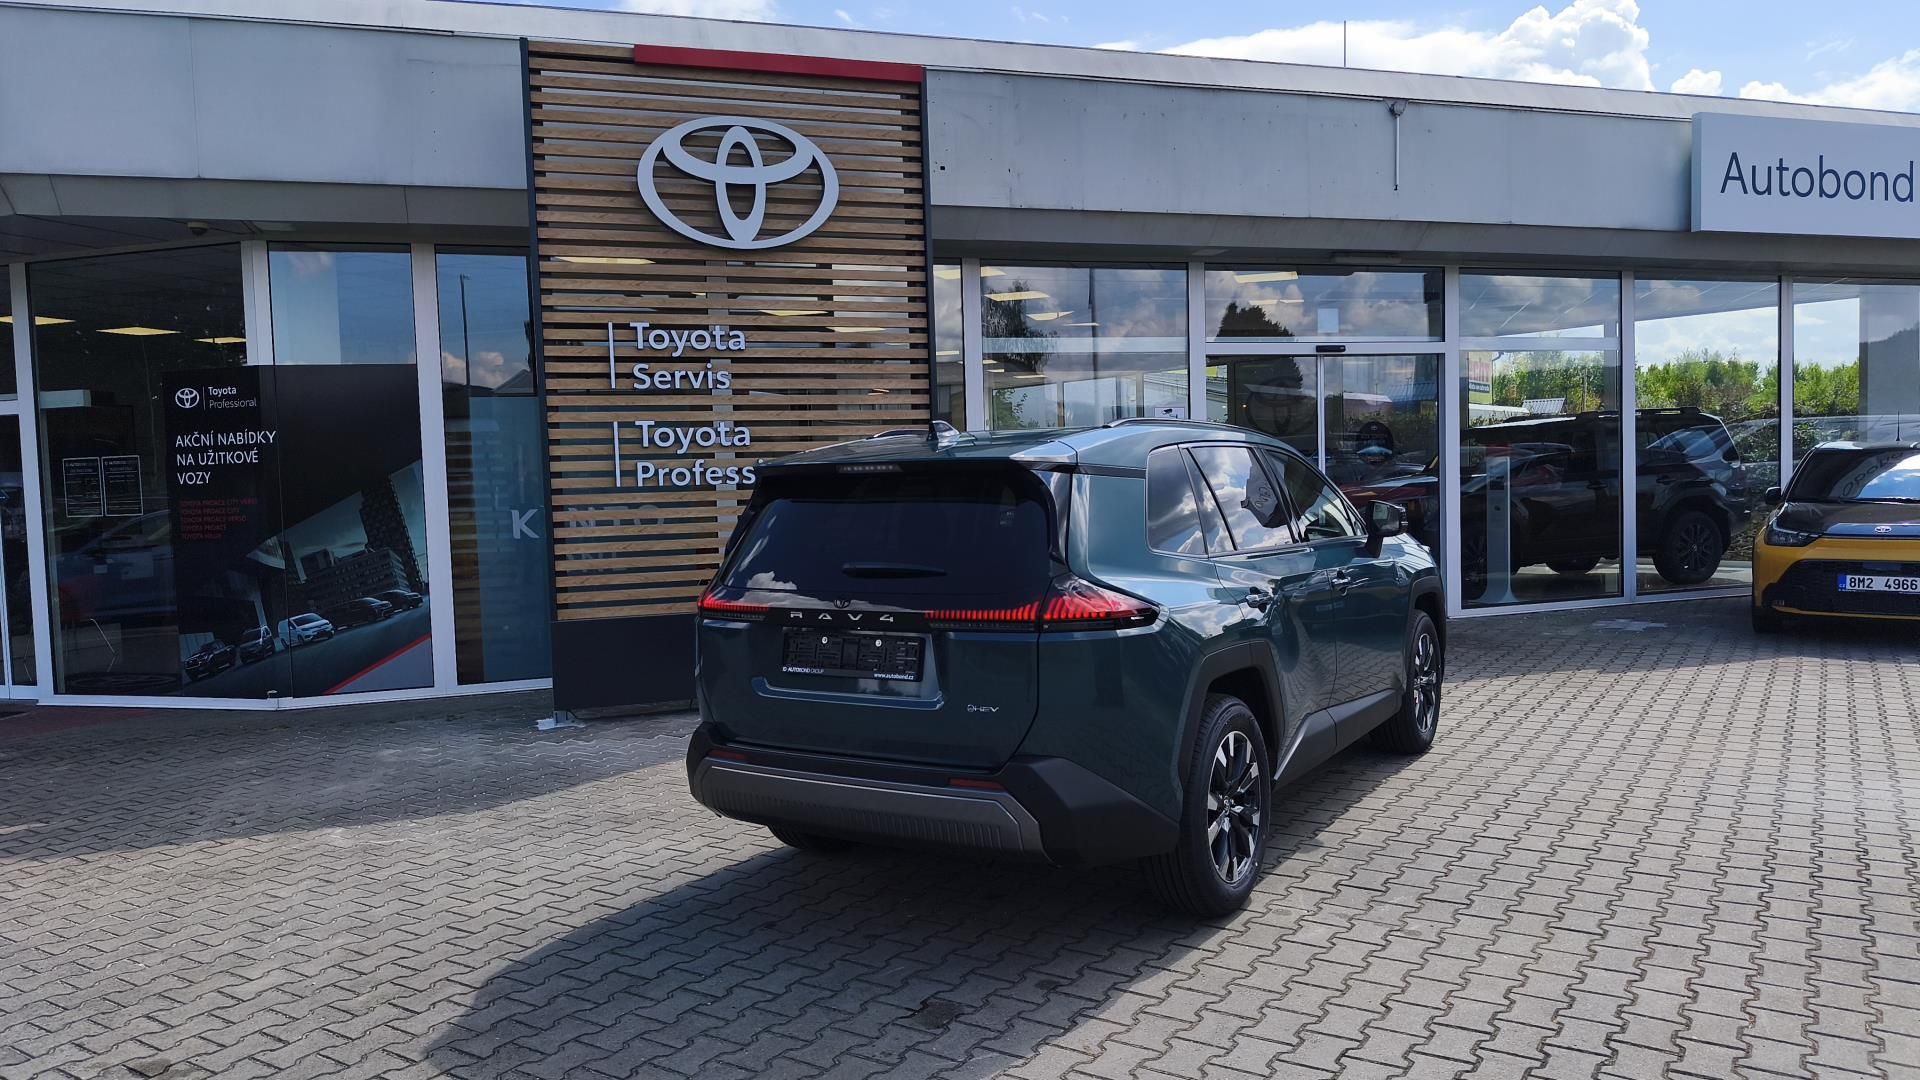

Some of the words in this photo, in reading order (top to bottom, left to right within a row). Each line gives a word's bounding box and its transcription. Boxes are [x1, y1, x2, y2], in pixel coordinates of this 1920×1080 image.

[1720, 152, 1914, 203] Autobond
[629, 322, 746, 357] Toyota
[632, 363, 730, 390] Servis
[208, 386, 237, 397] Toyota
[209, 397, 257, 409] Professional
[175, 430, 214, 448] AKČNÍ
[217, 428, 277, 446] NABÍDKY
[635, 420, 750, 454] Toyota
[176, 453, 195, 467] NA
[198, 447, 259, 465] UŽITKOVÉ
[177, 471, 211, 485] VOZY
[637, 458, 765, 487] Profess
[1849, 577, 1874, 589] 8M2
[1884, 578, 1918, 591] 4966
[790, 611, 894, 622] RAV4
